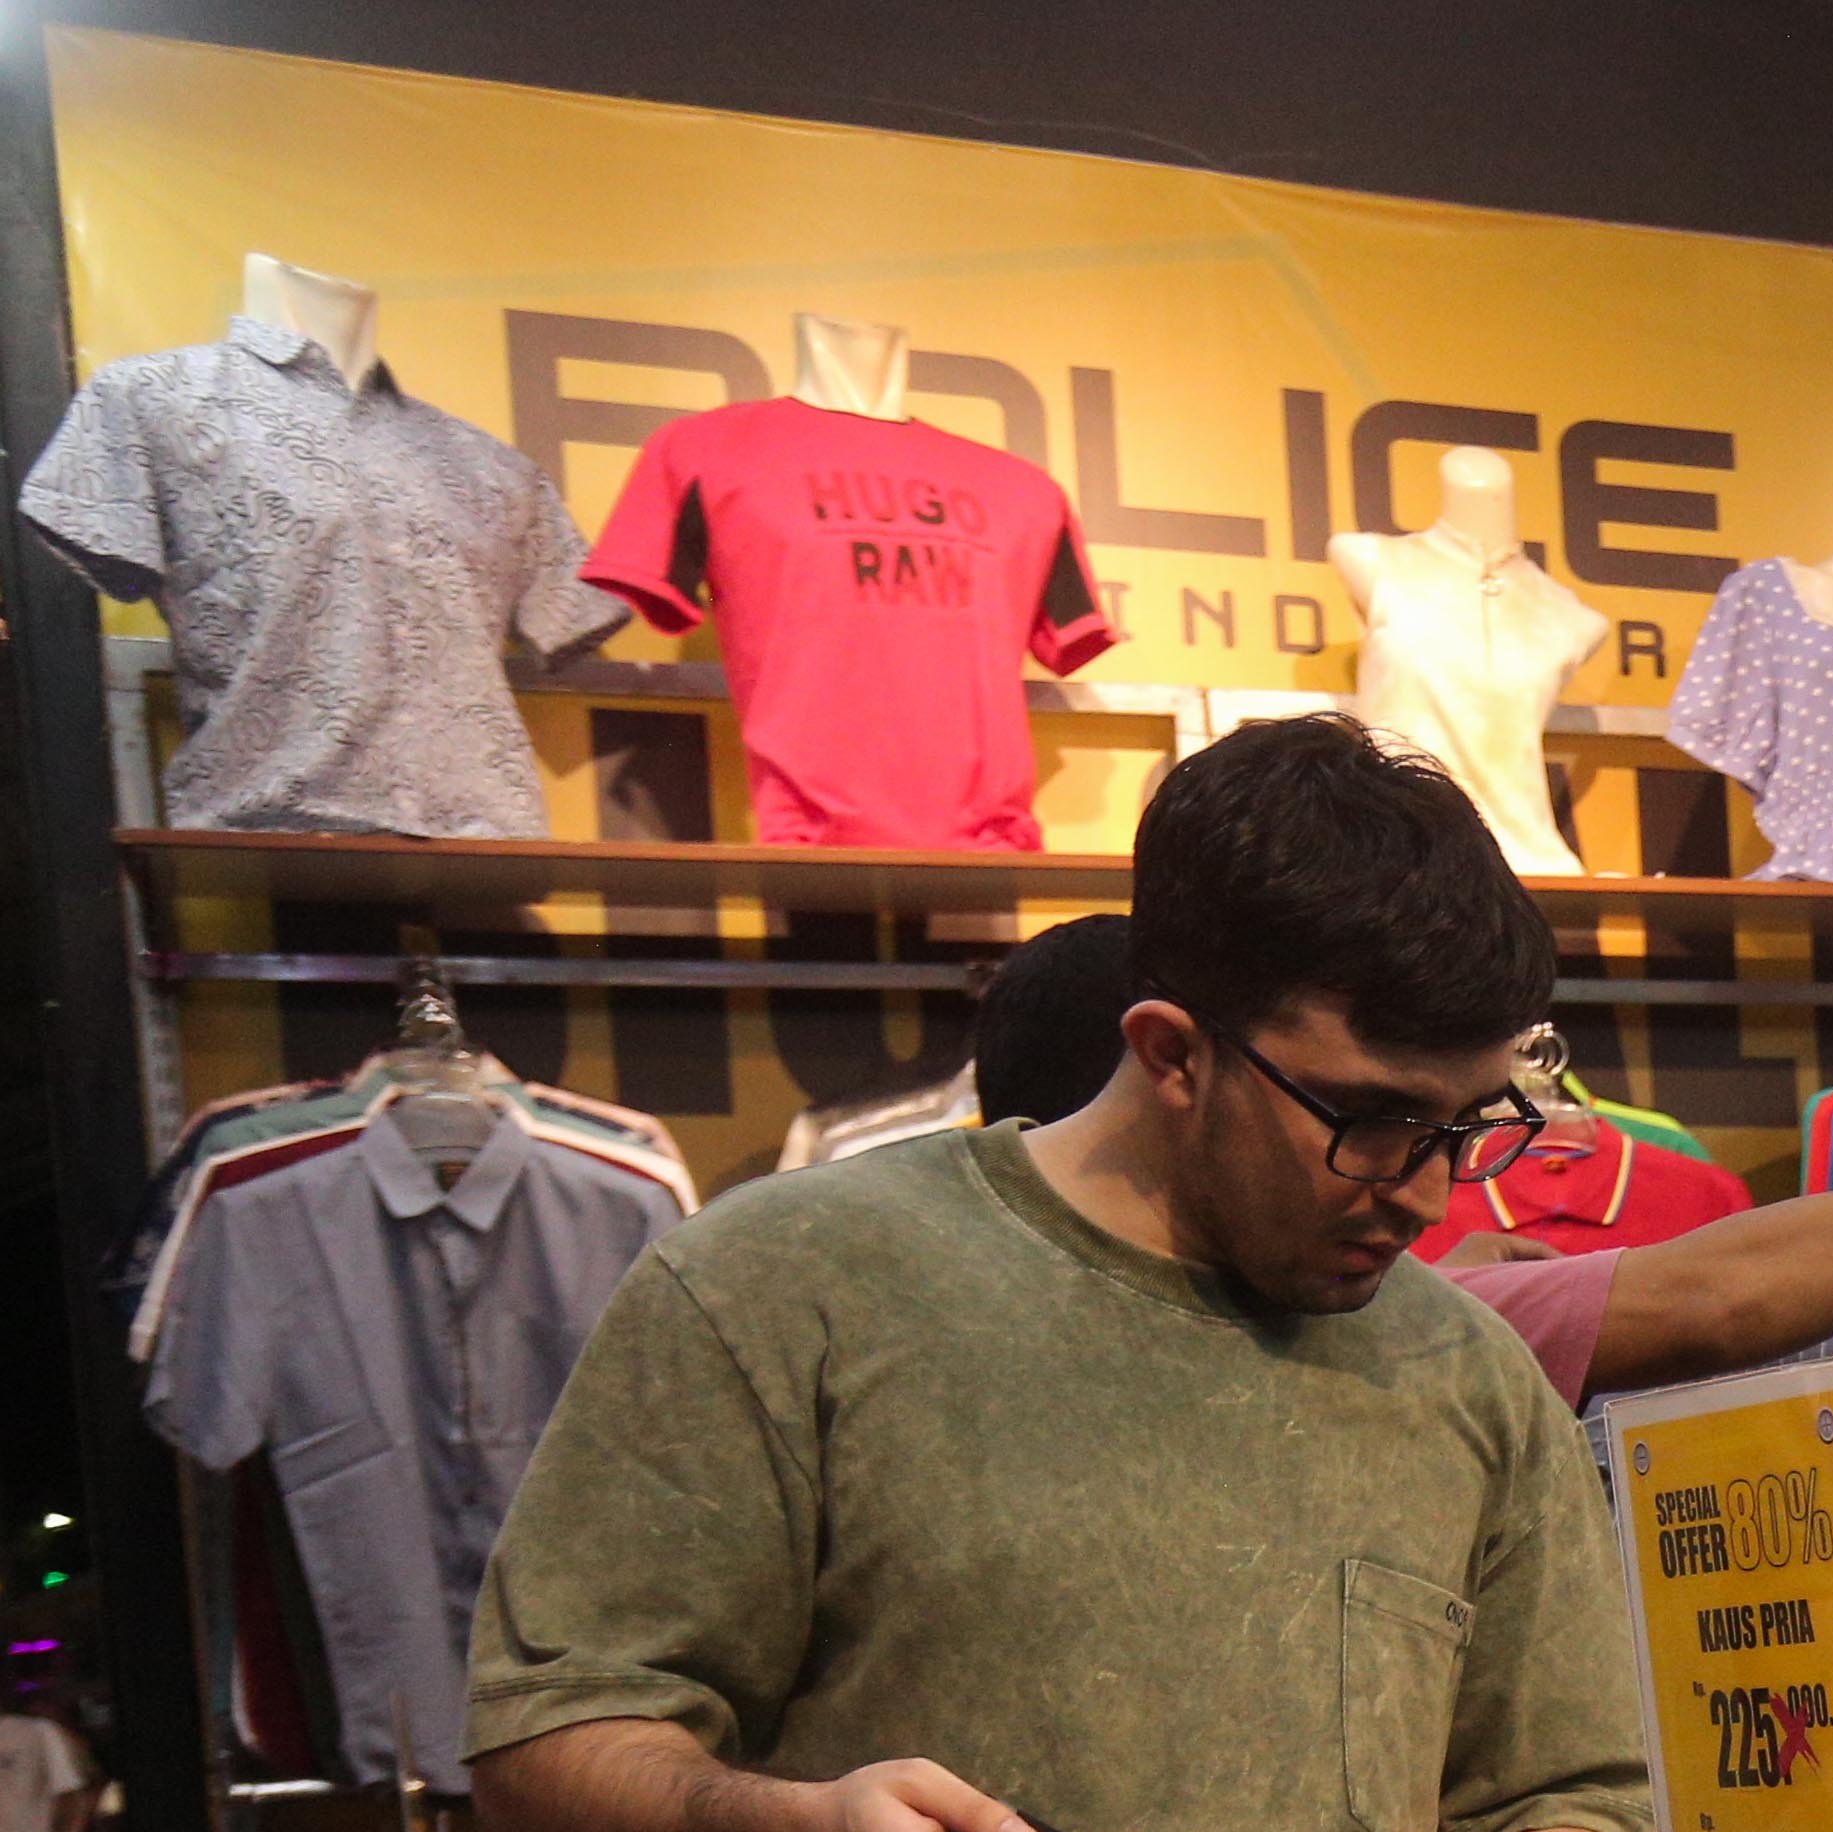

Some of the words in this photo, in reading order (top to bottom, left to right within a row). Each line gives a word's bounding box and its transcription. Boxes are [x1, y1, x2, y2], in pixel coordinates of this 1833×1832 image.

[812, 471, 988, 537] HUGO
[850, 541, 974, 607] RAW
[1655, 1484, 1721, 1527] SPECIAL
[1658, 1523, 1730, 1579] OFFER
[1696, 1605, 1758, 1653] KAUS
[1760, 1599, 1815, 1647] PRIA
